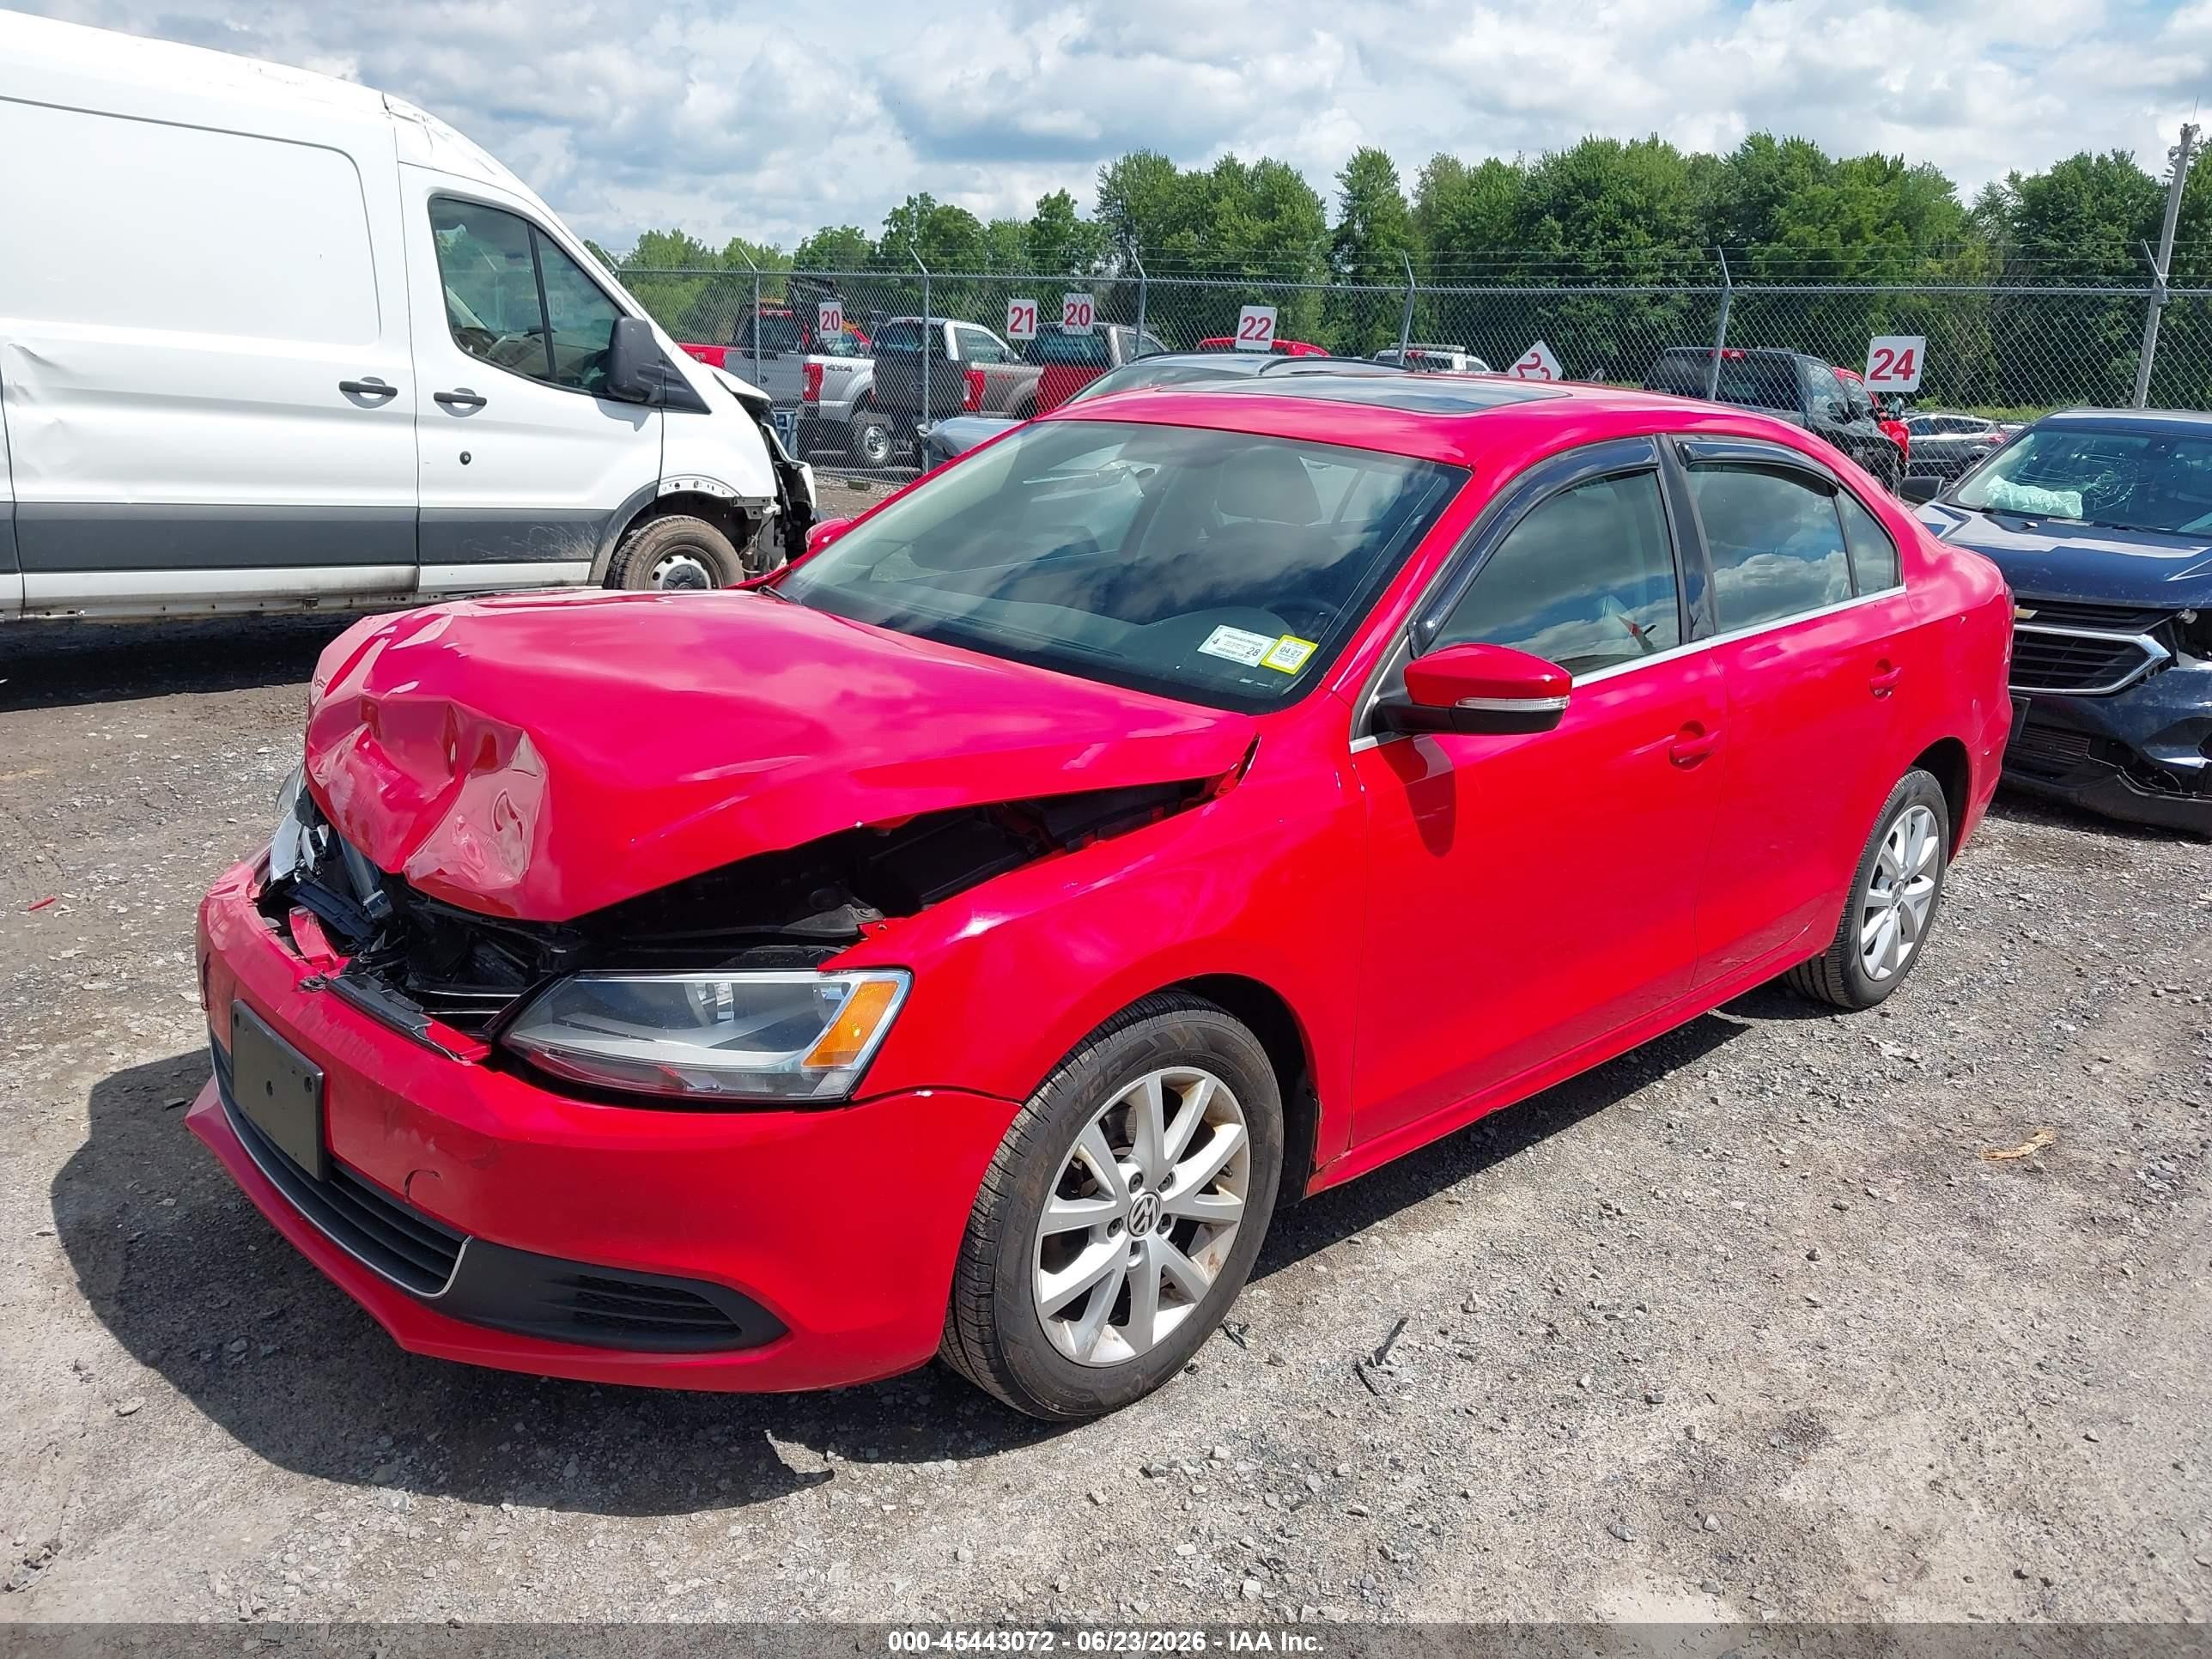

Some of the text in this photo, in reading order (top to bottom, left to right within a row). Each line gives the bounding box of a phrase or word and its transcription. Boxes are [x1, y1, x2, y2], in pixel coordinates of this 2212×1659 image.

[821, 310, 840, 331] 20
[1010, 307, 1035, 333] 21
[1065, 303, 1090, 326] 20
[1239, 315, 1272, 342] 22
[1869, 348, 1916, 380] 24
[1246, 647, 1261, 657] 28
